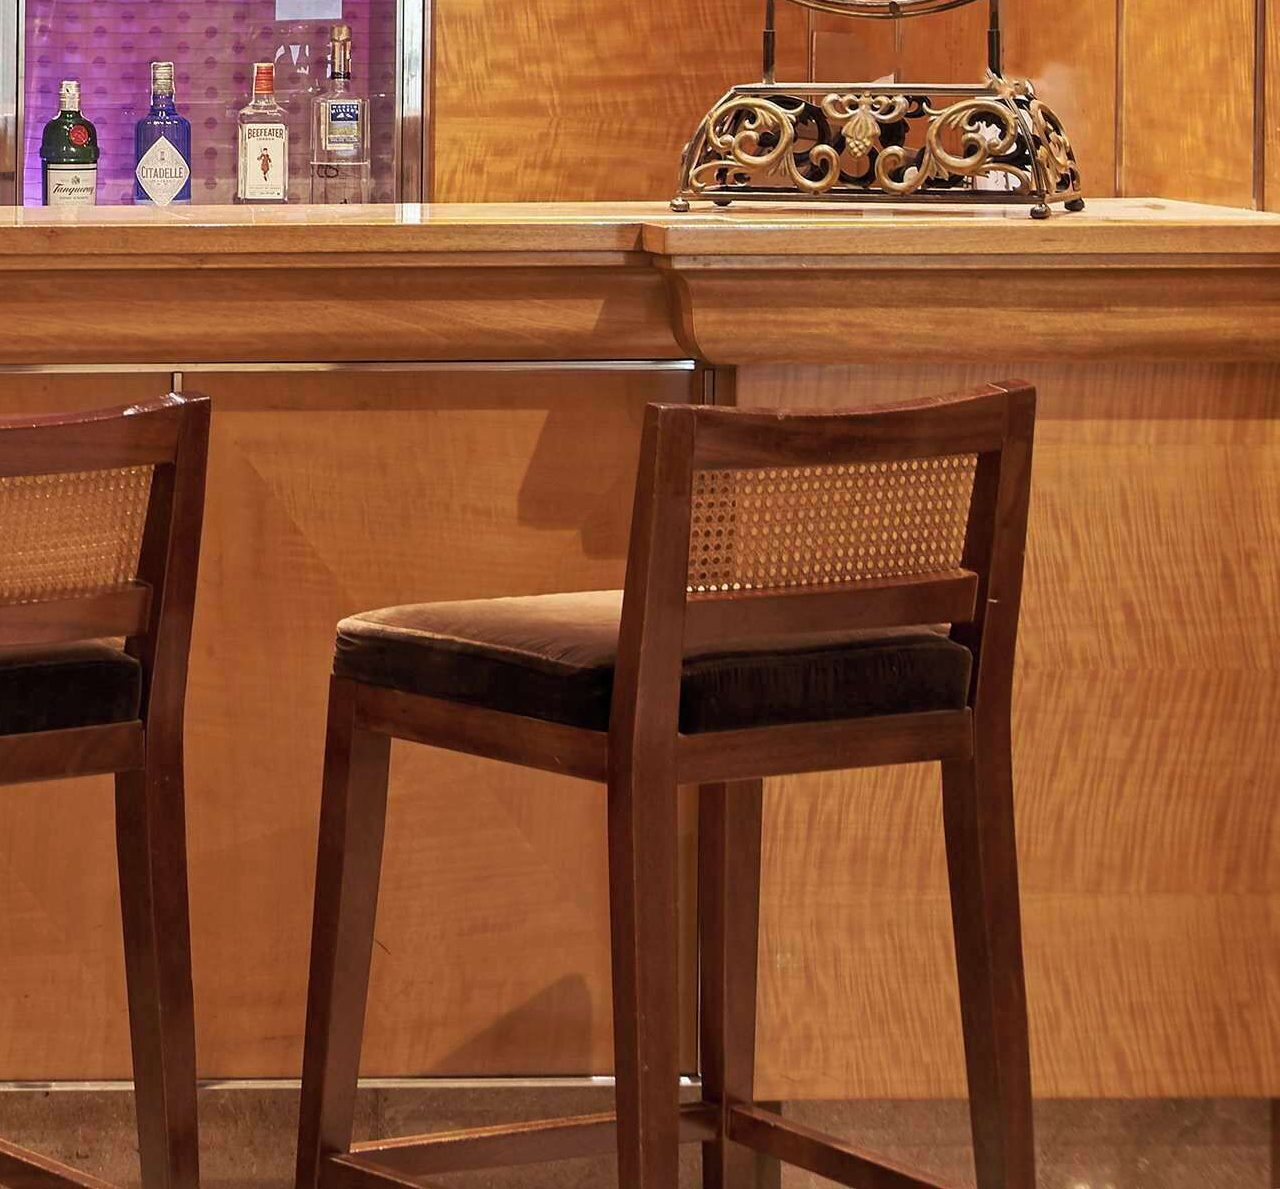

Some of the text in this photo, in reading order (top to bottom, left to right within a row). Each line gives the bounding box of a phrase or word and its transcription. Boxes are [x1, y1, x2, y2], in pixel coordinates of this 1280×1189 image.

[248, 128, 283, 139] BEEFEATER
[141, 165, 184, 179] CITADELLE
[53, 183, 94, 195] Tanqueray
